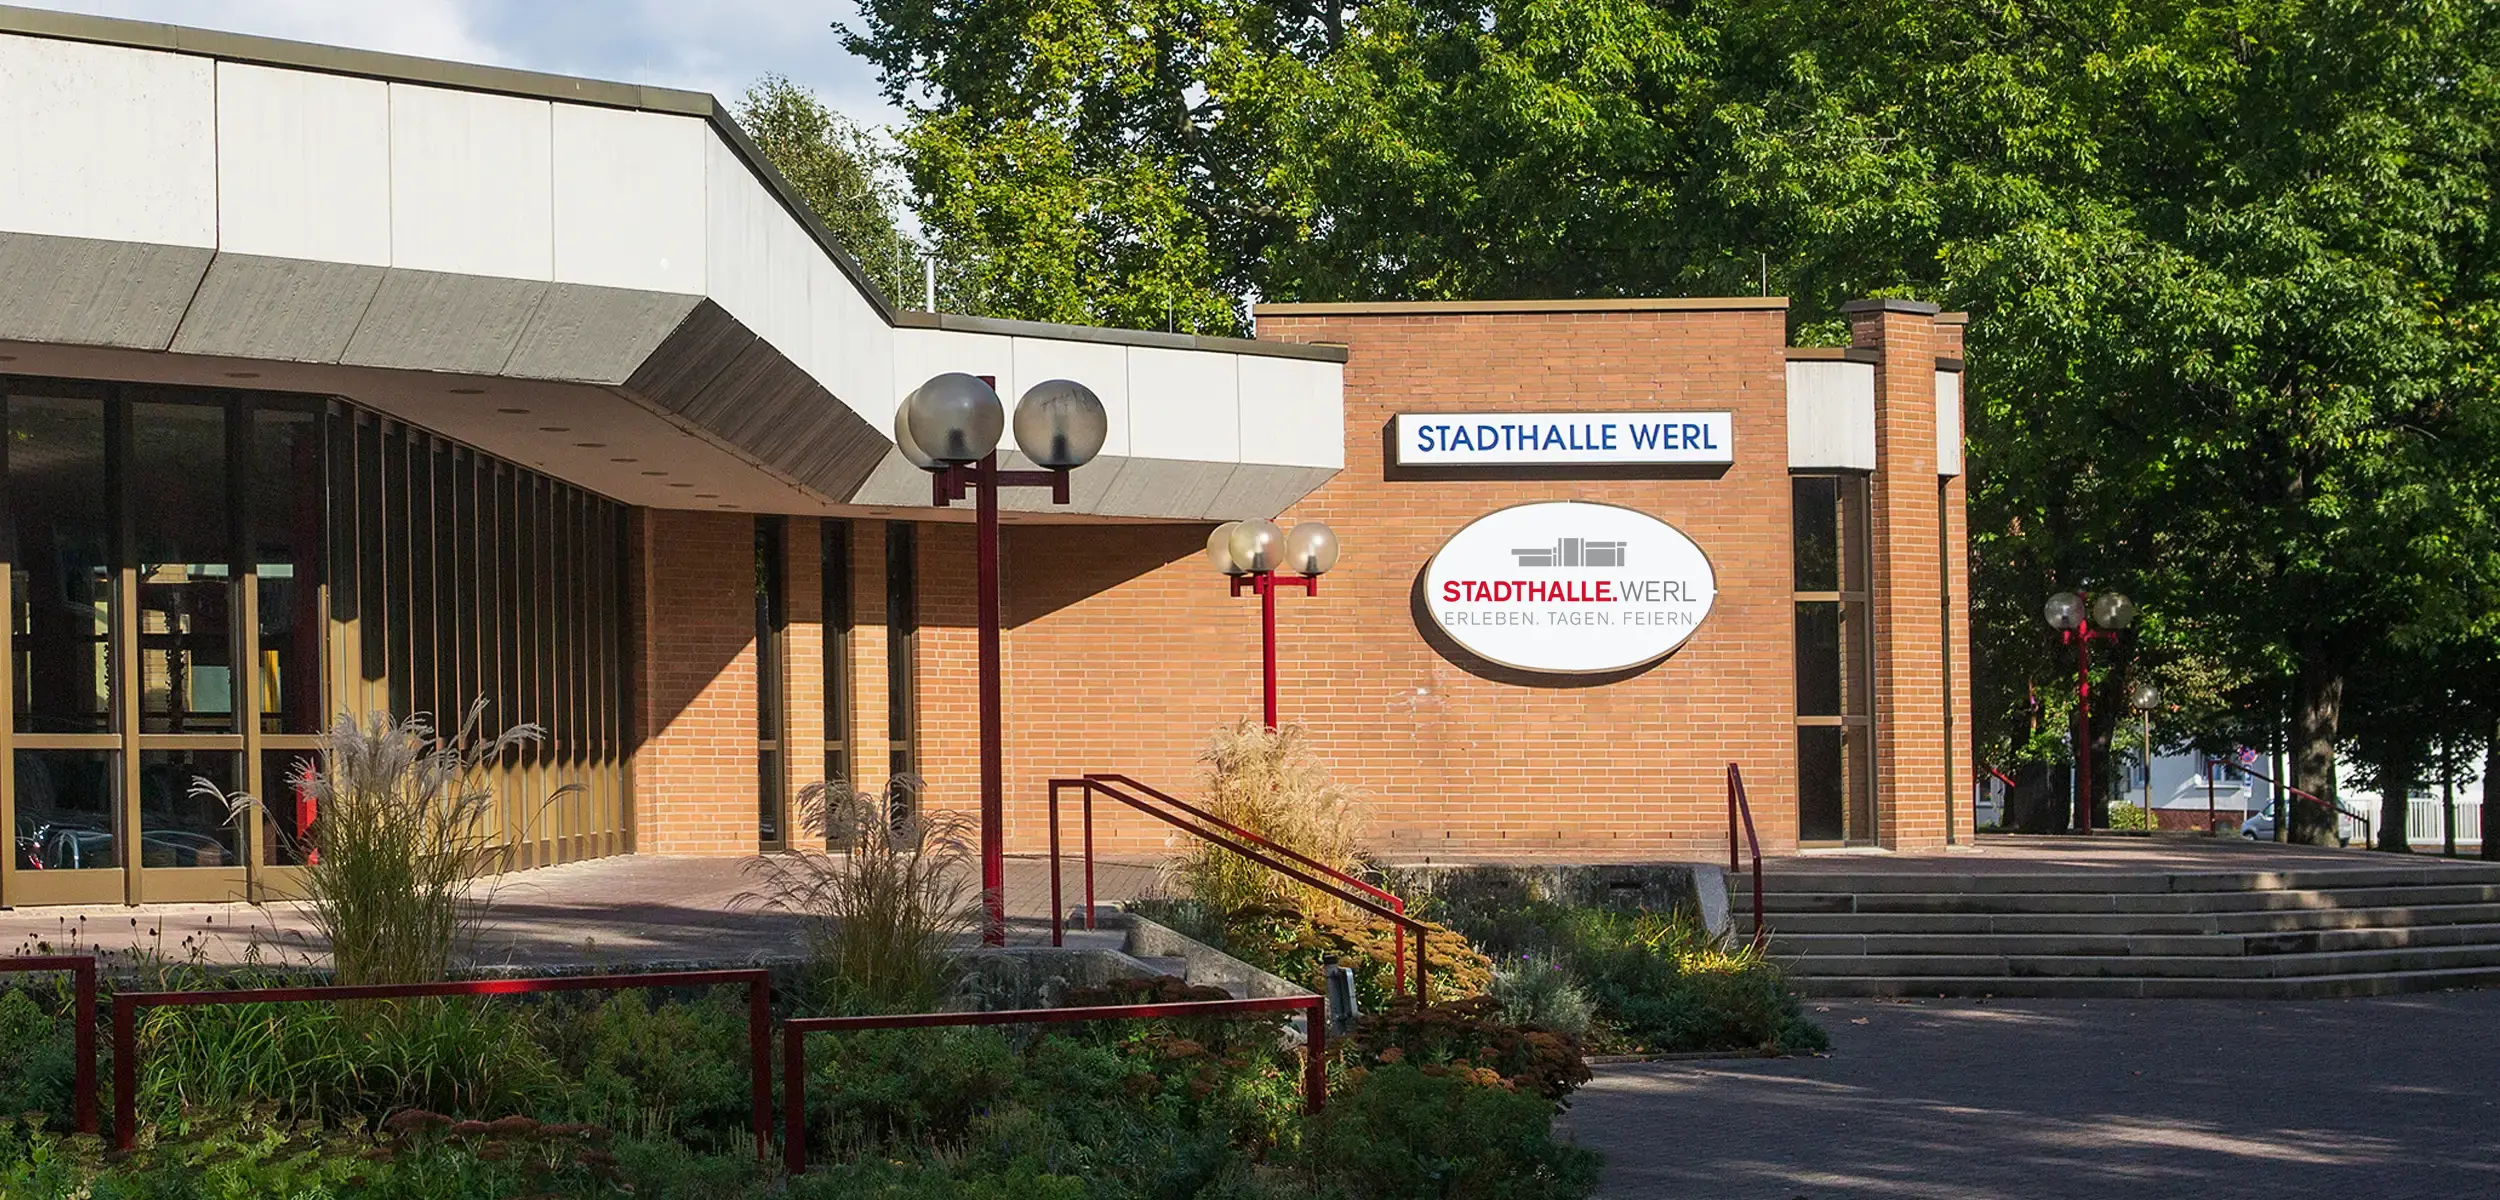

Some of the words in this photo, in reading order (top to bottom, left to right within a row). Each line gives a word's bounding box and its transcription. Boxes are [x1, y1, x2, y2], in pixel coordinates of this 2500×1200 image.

[1418, 424, 1617, 452] STADTHALLE
[1629, 424, 1717, 450] WERL
[1444, 612, 1539, 626] ERLEBEN.
[1548, 612, 1614, 626] TAGEN.
[1623, 611, 1698, 625] FEIERN.
